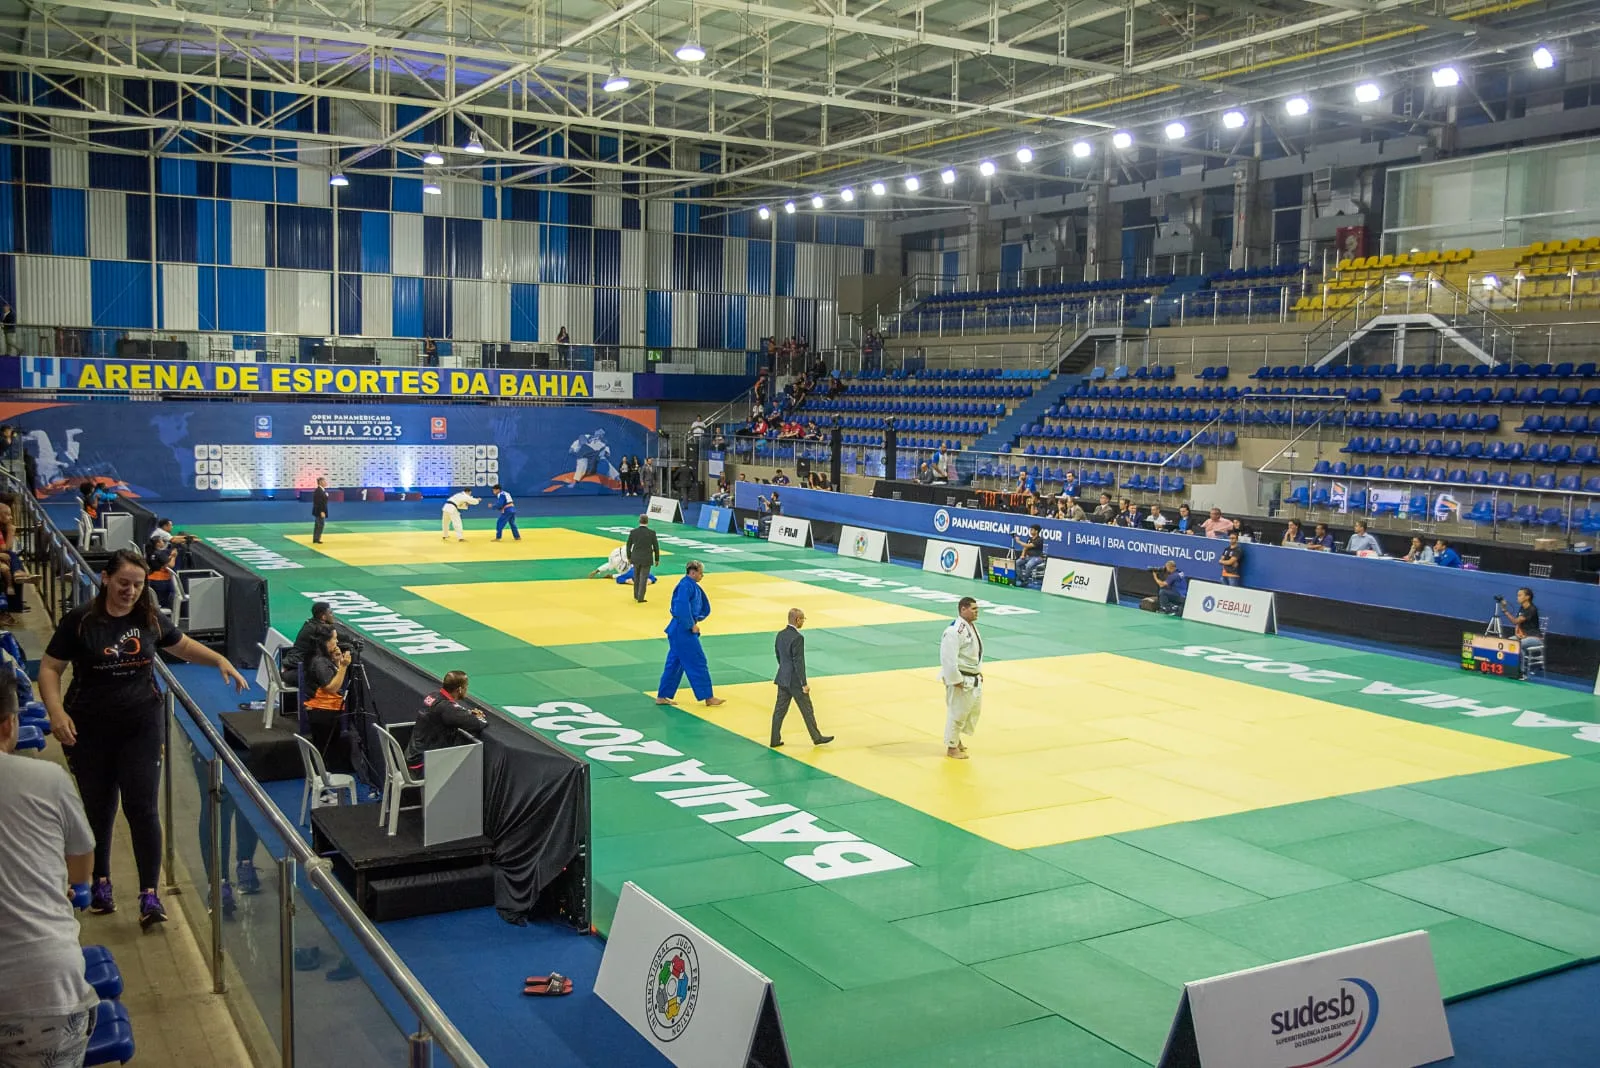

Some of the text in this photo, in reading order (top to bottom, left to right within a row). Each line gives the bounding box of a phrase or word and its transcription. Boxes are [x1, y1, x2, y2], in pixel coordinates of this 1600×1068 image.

[77, 364, 589, 397] ARENA DE ESPORTES DA BAHIA
[303, 425, 403, 437] BAHIA 2023
[361, 489, 368, 501] 1
[400, 493, 406, 501] 3
[952, 517, 1010, 534] PANAMERICAN
[1075, 533, 1216, 562] BAHIA BRA CONTINENTAL CUP
[794, 568, 910, 588] 2023
[1073, 575, 1090, 586] CBJ
[1216, 599, 1251, 614] FEBAJU
[300, 590, 471, 655] BAHIA 2023
[1160, 645, 1364, 684] 2023
[1480, 661, 1503, 674] 0:13
[502, 701, 914, 881] BAHIA 2023
[647, 938, 698, 1036] INTERNATIONAL JUDO FEDERATION
[1270, 987, 1355, 1035] sudesb
[1294, 1030, 1342, 1049] DO ESTADO DA BAHIA
